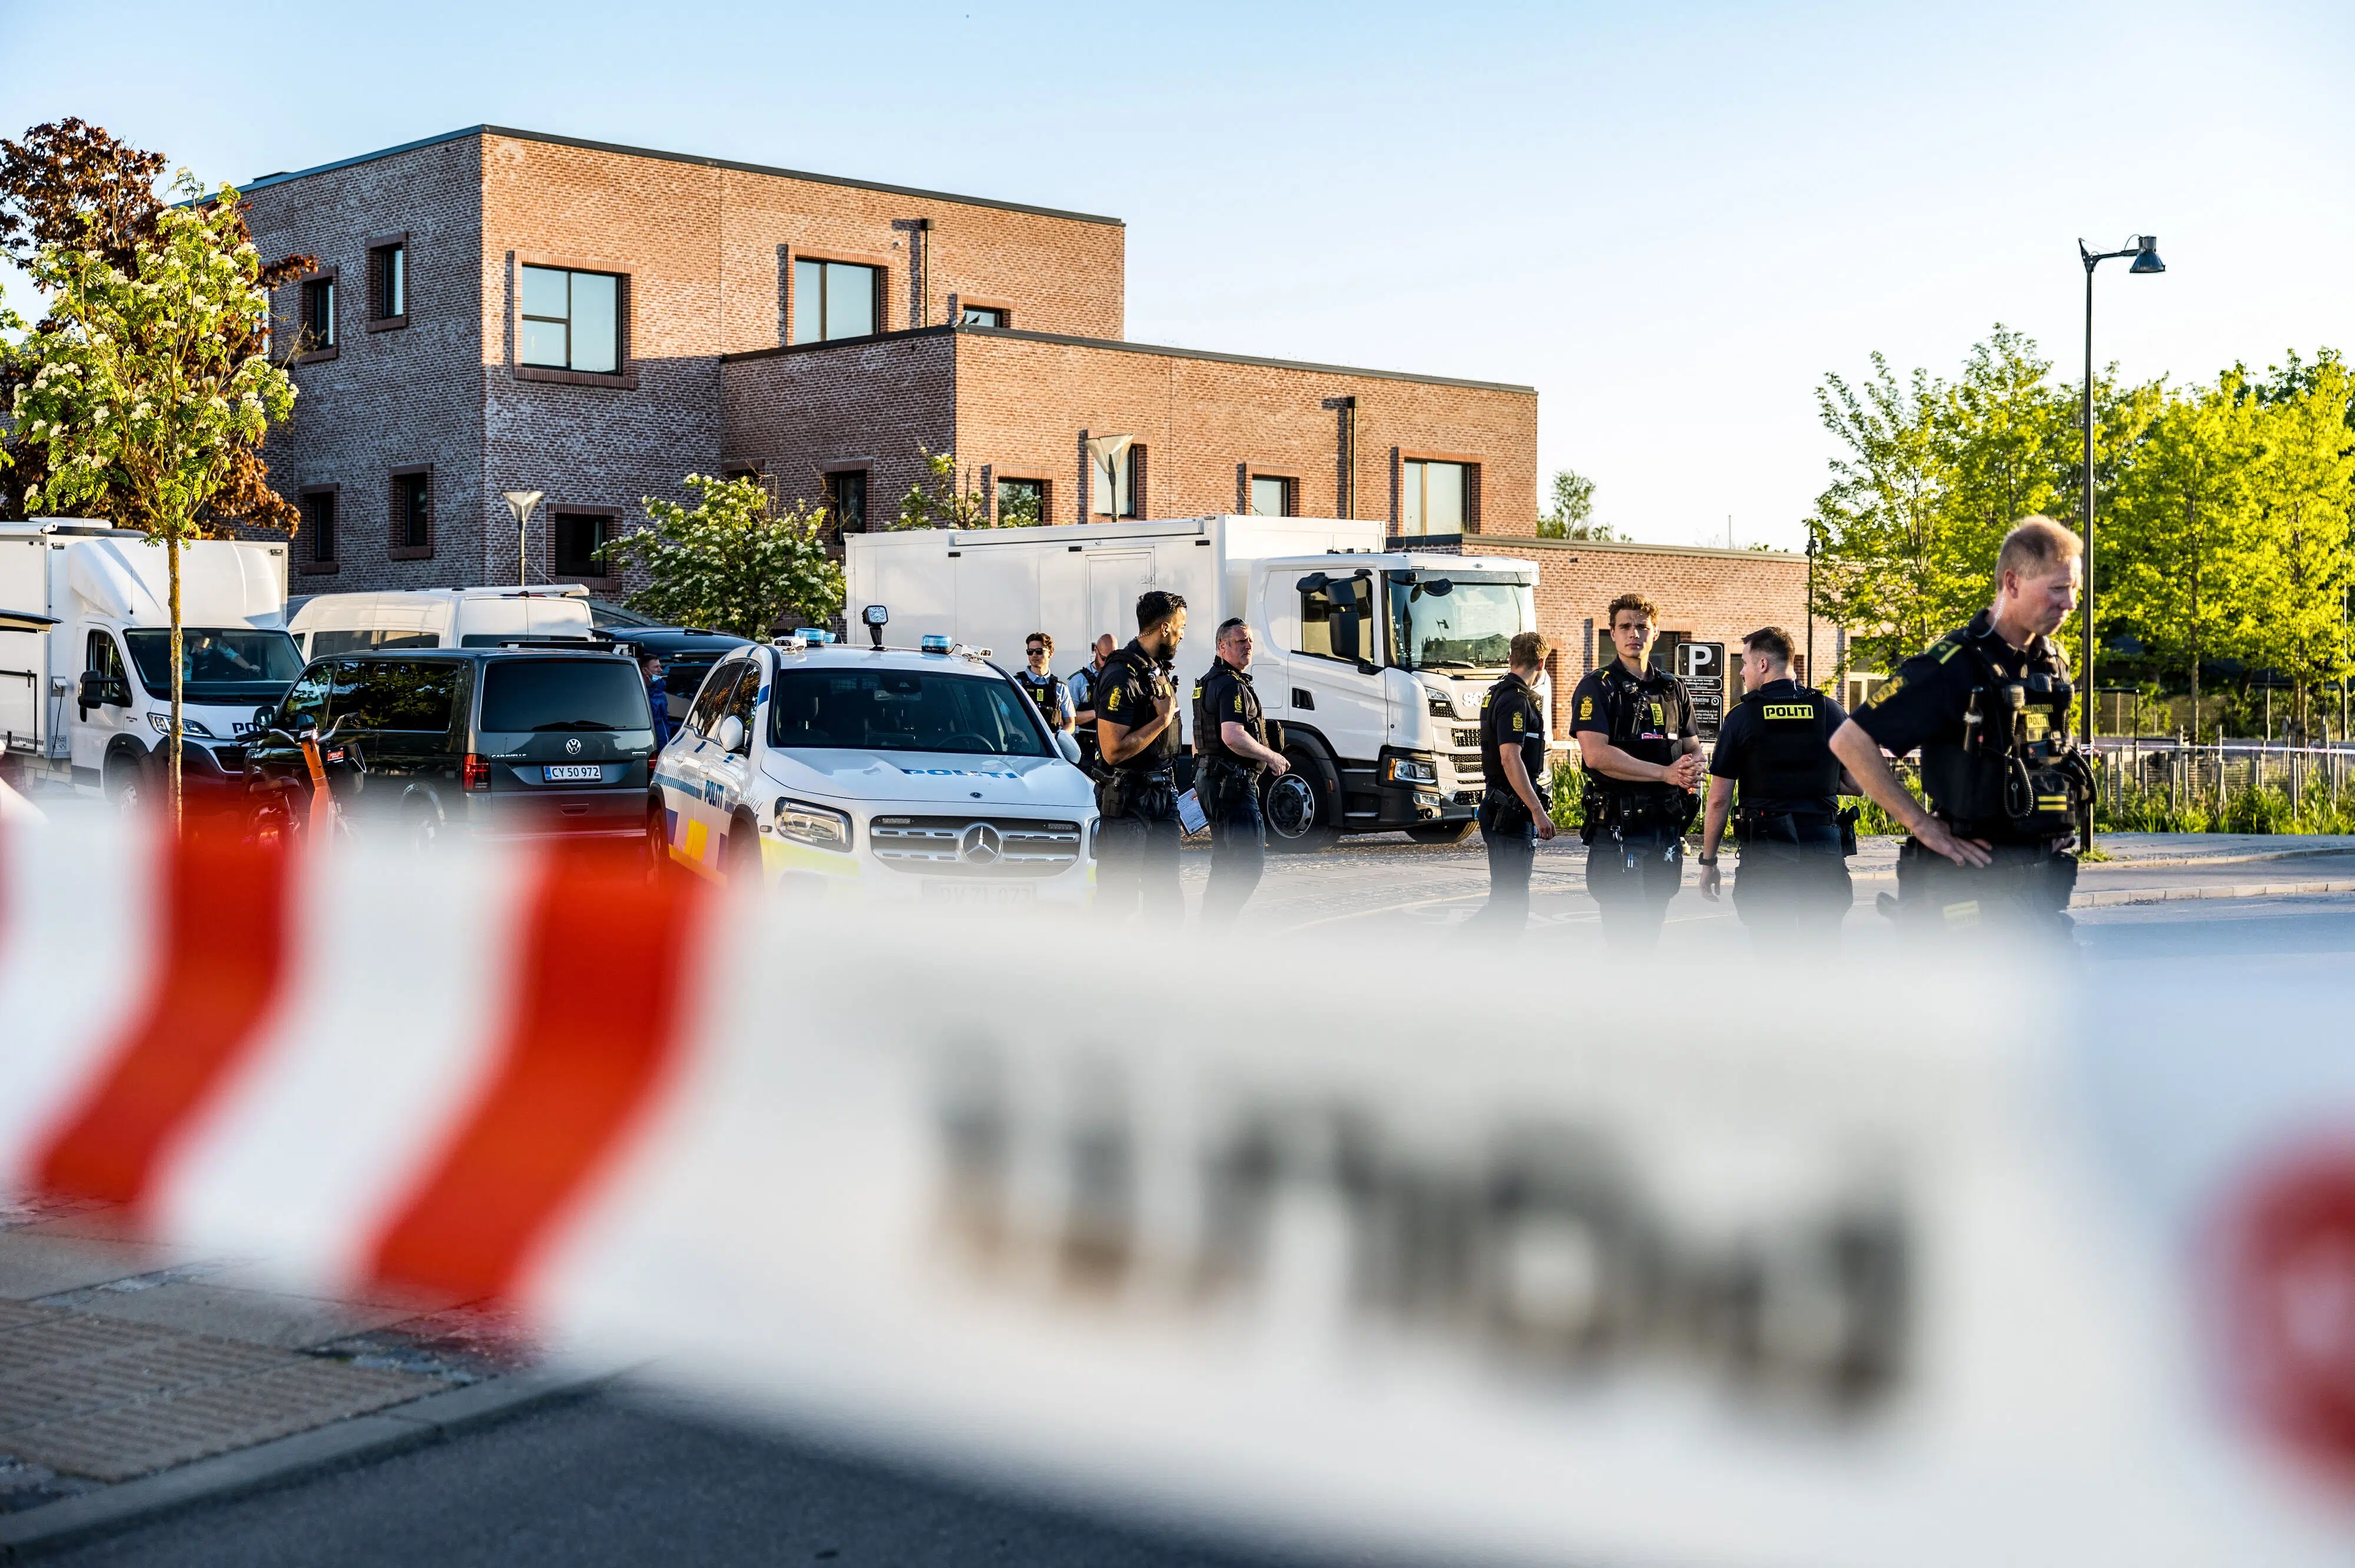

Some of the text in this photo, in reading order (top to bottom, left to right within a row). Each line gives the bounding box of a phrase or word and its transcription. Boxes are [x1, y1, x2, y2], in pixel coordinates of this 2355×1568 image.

[1689, 646, 1712, 676] P
[1766, 707, 1812, 717] POLITI
[2028, 715, 2048, 725] POLITI
[232, 723, 258, 734] PO
[552, 767, 599, 777] CY 50 972
[900, 769, 1017, 778] POLITI
[705, 779, 724, 809] POLITI
